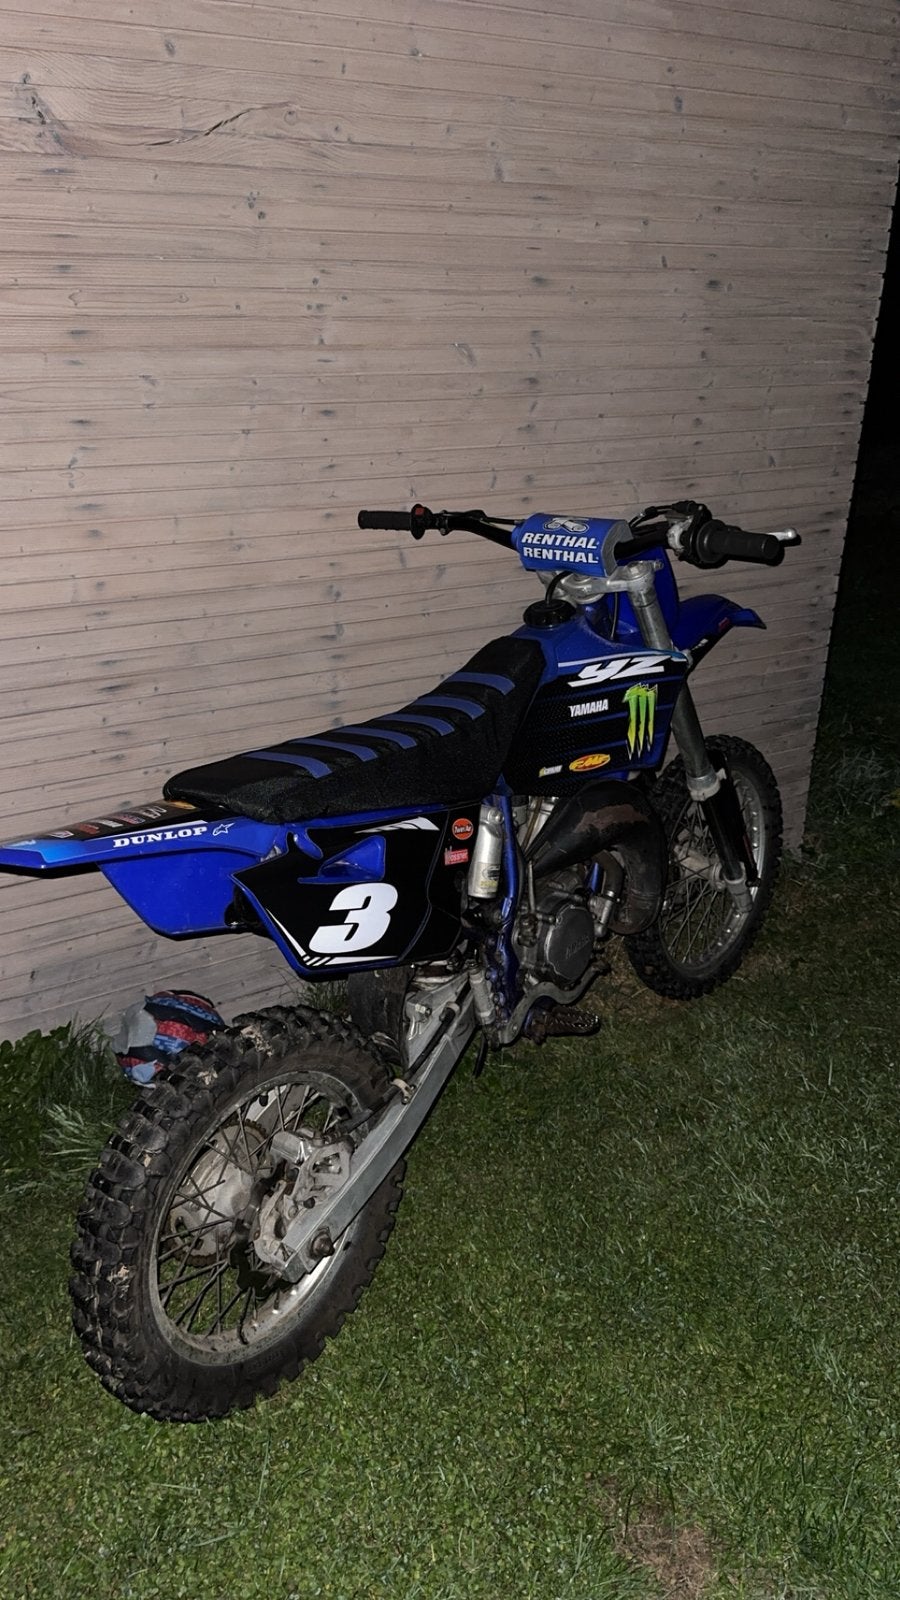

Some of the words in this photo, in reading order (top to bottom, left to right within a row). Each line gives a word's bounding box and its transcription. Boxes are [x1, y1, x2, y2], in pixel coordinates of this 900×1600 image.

[521, 532, 598, 549] RENTHAL
[523, 547, 599, 564] RENTHAL
[568, 699, 609, 717] YAMAHA
[112, 826, 208, 848] DUNLOP
[308, 882, 398, 954] 3
